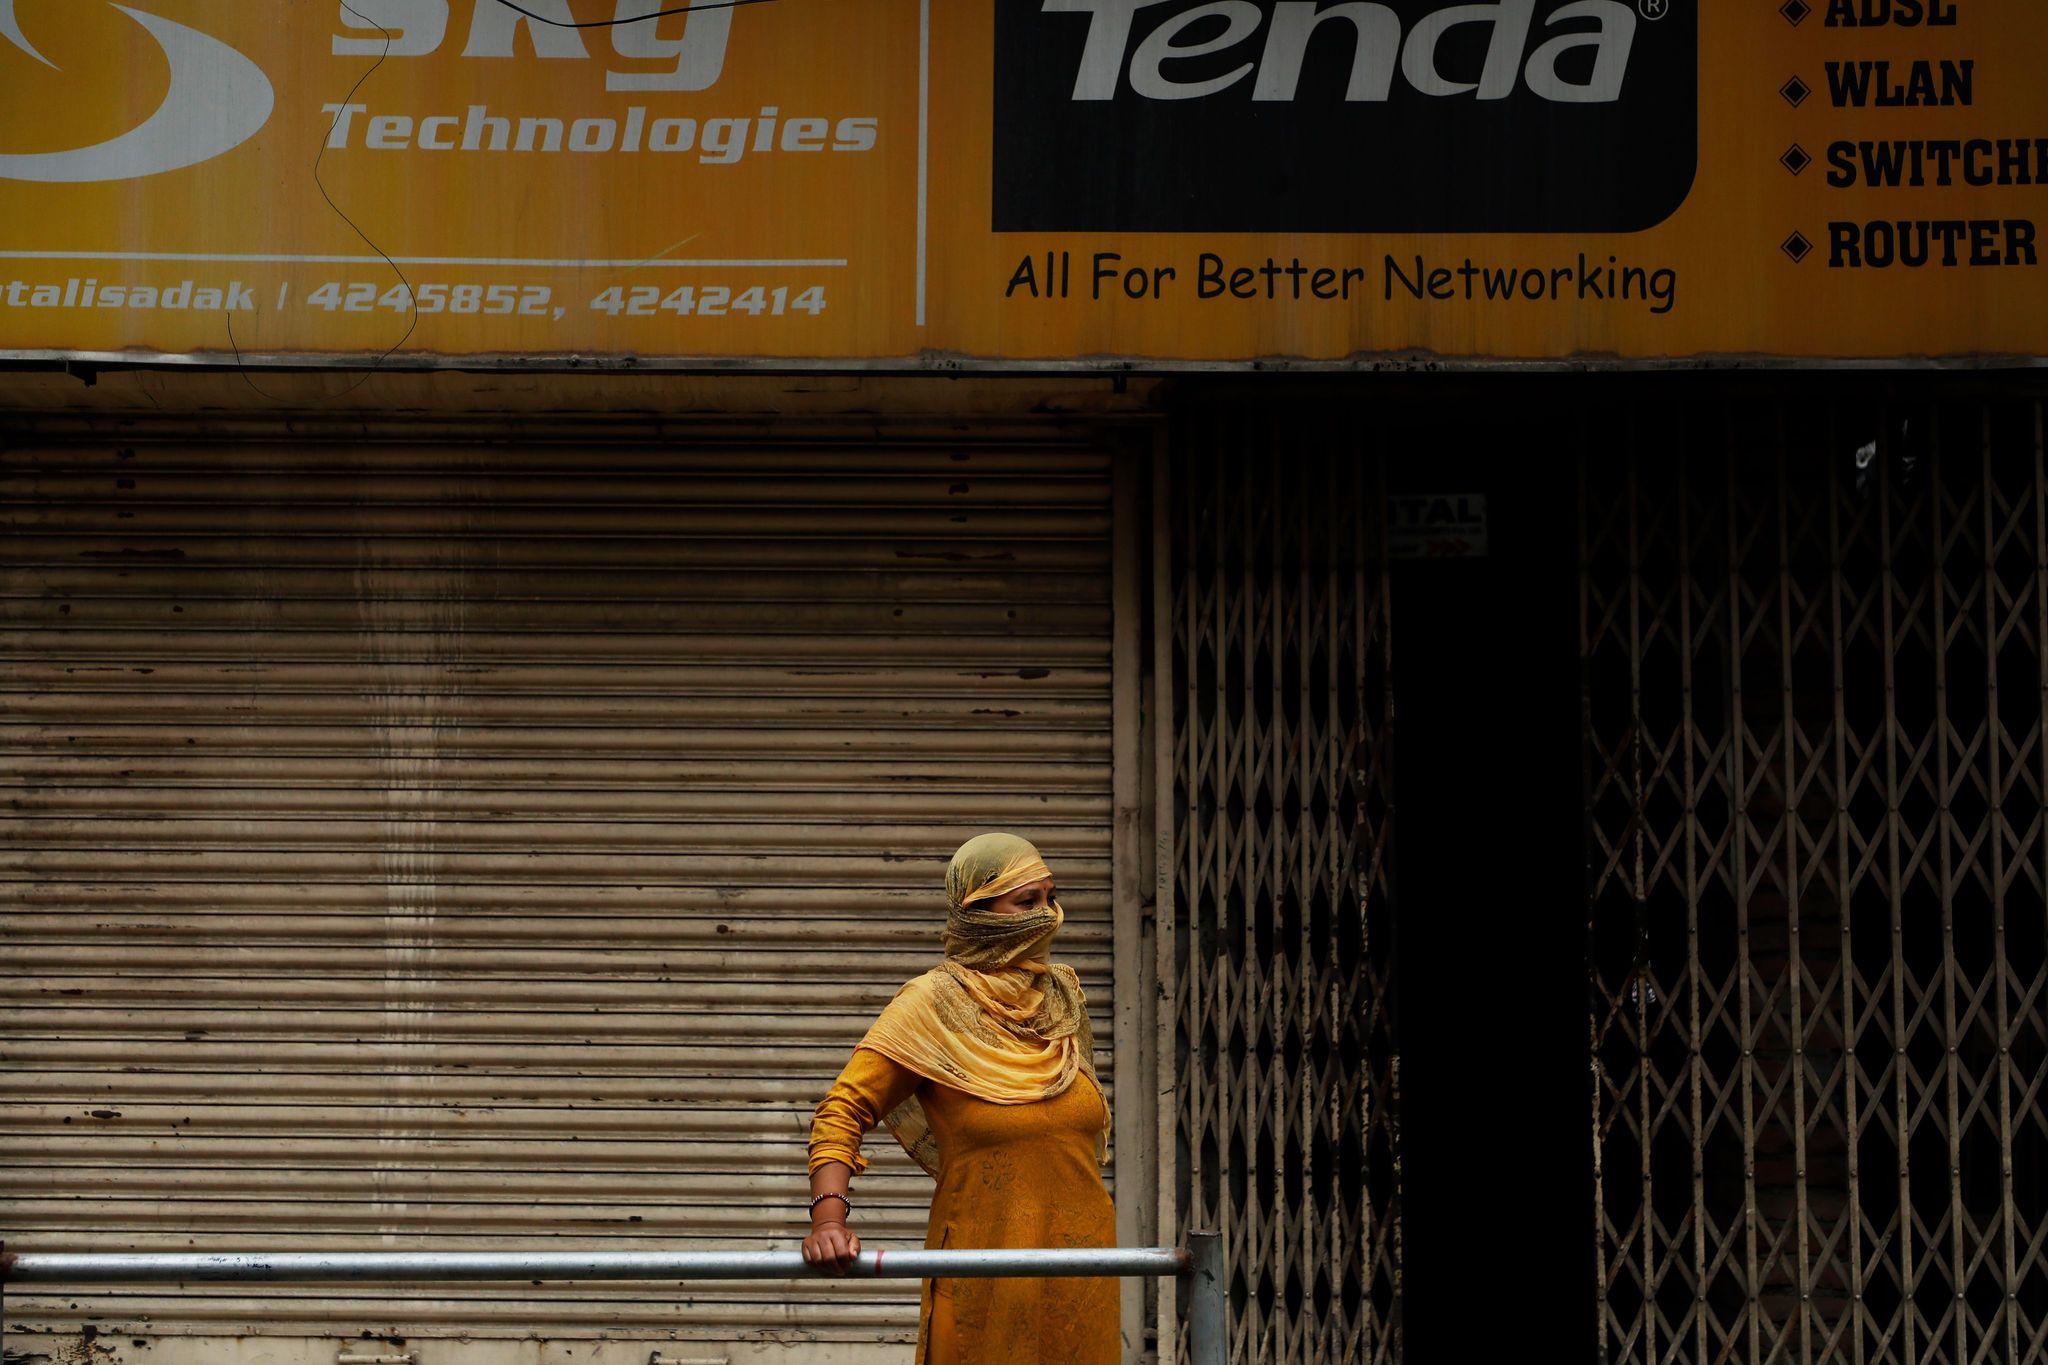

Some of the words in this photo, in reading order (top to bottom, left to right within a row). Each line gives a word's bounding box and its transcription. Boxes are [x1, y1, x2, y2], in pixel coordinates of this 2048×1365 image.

[1824, 0, 1957, 27] ADSL
[1041, 0, 1637, 103] Tenda
[1824, 59, 1974, 107] WLAN
[321, 103, 878, 164] Technologies
[1828, 219, 2038, 268] ROUTER
[0, 278, 255, 312] talisadak
[306, 282, 566, 321] 4245852,
[590, 286, 827, 316] 4242414
[1005, 251, 1069, 298] All
[1092, 252, 1176, 300] For
[1197, 252, 1365, 300] Better
[1384, 252, 1676, 314] Networking
